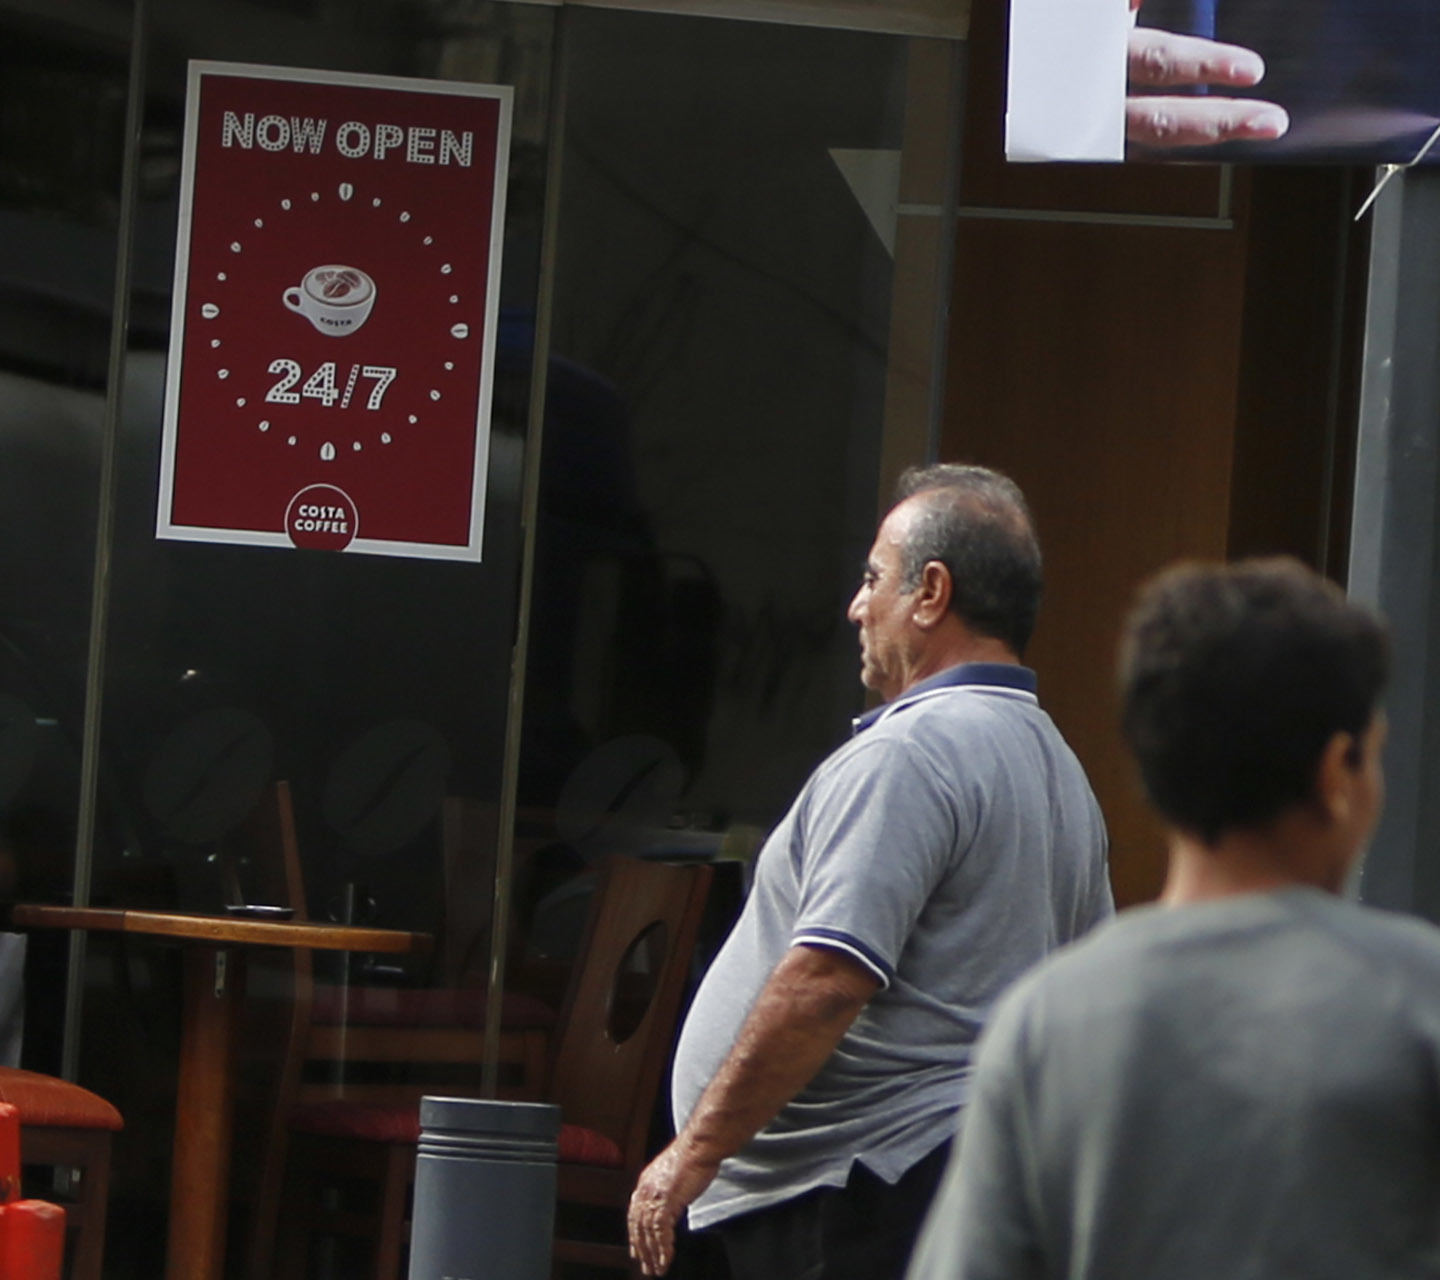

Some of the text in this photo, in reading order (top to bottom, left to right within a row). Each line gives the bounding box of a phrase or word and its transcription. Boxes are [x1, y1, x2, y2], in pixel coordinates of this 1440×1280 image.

[222, 111, 474, 167] NOW OPEN
[264, 358, 397, 410] 24/7
[294, 518, 348, 535] COFFEE
[298, 505, 345, 520] COSTA
